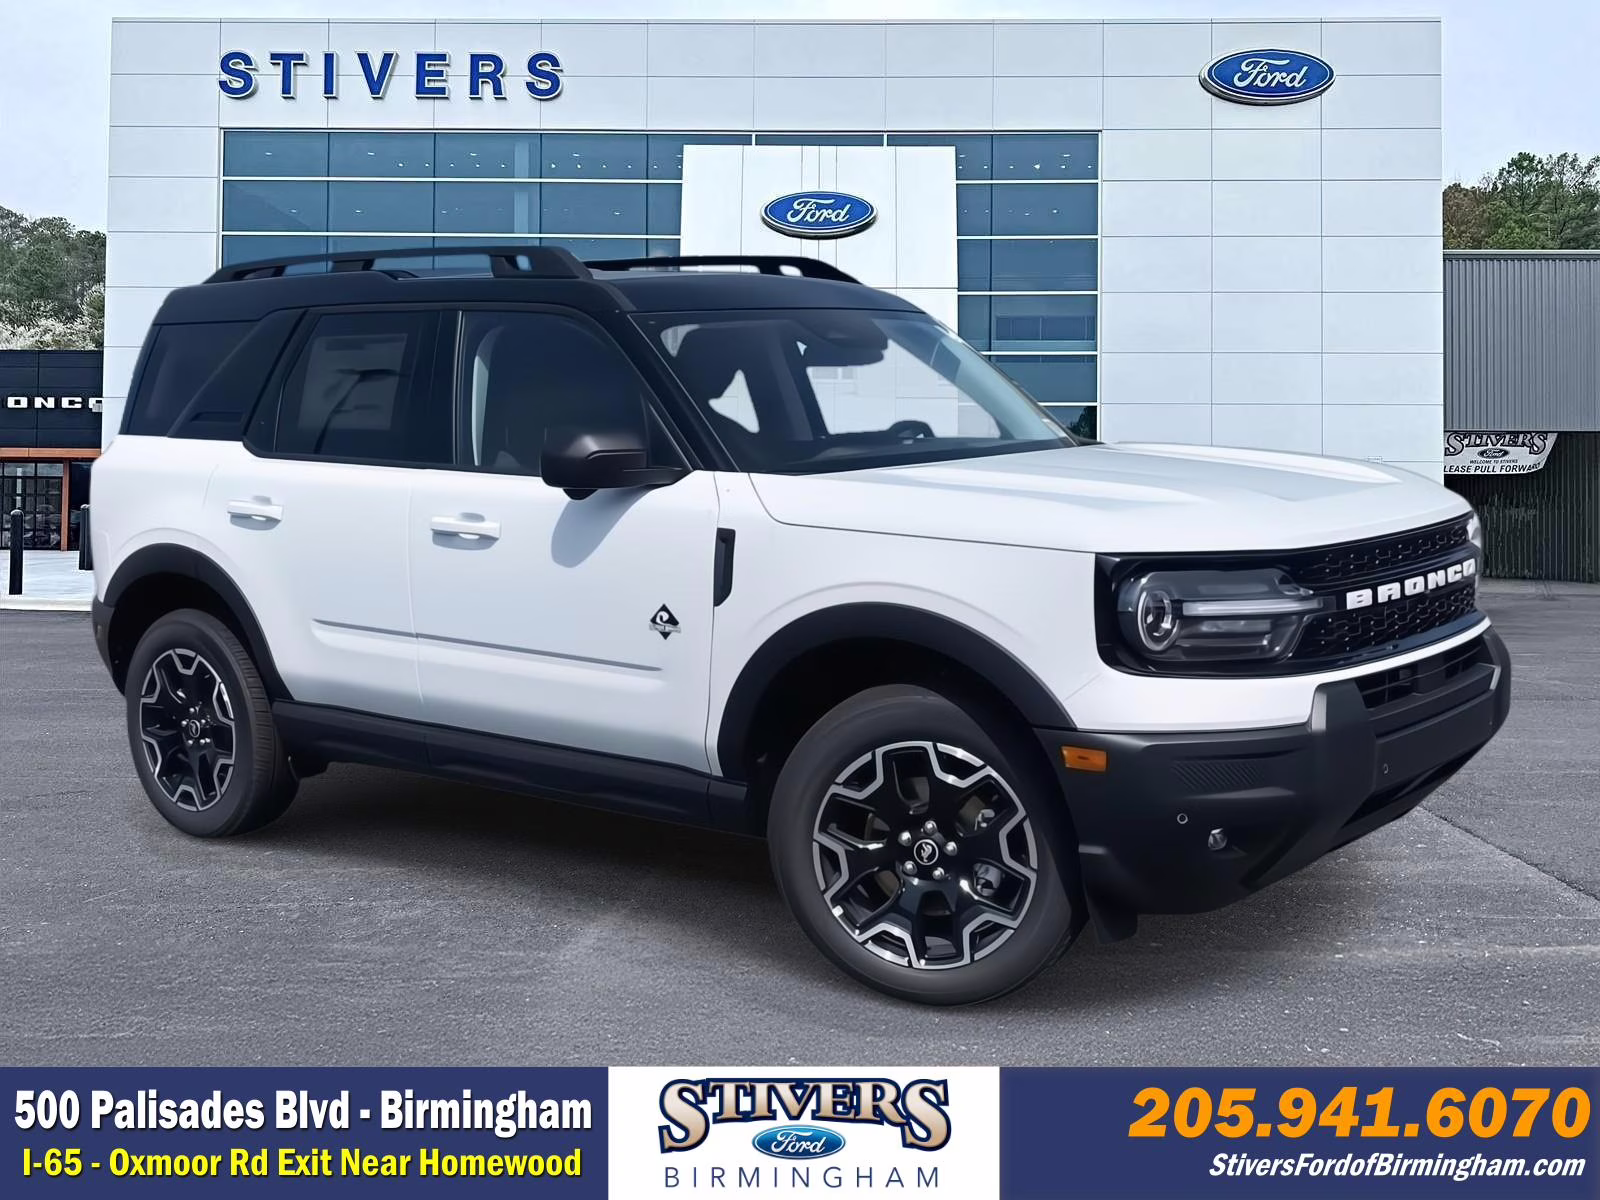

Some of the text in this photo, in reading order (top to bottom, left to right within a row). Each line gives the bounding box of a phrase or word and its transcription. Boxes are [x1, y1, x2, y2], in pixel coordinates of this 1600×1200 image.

[218, 51, 565, 101] STIVERS
[1233, 57, 1309, 88] Ford
[786, 198, 852, 223] Ford
[1444, 432, 1548, 456] STIVERS
[1474, 465, 1497, 473] PULL
[1346, 558, 1476, 610] BRONCO
